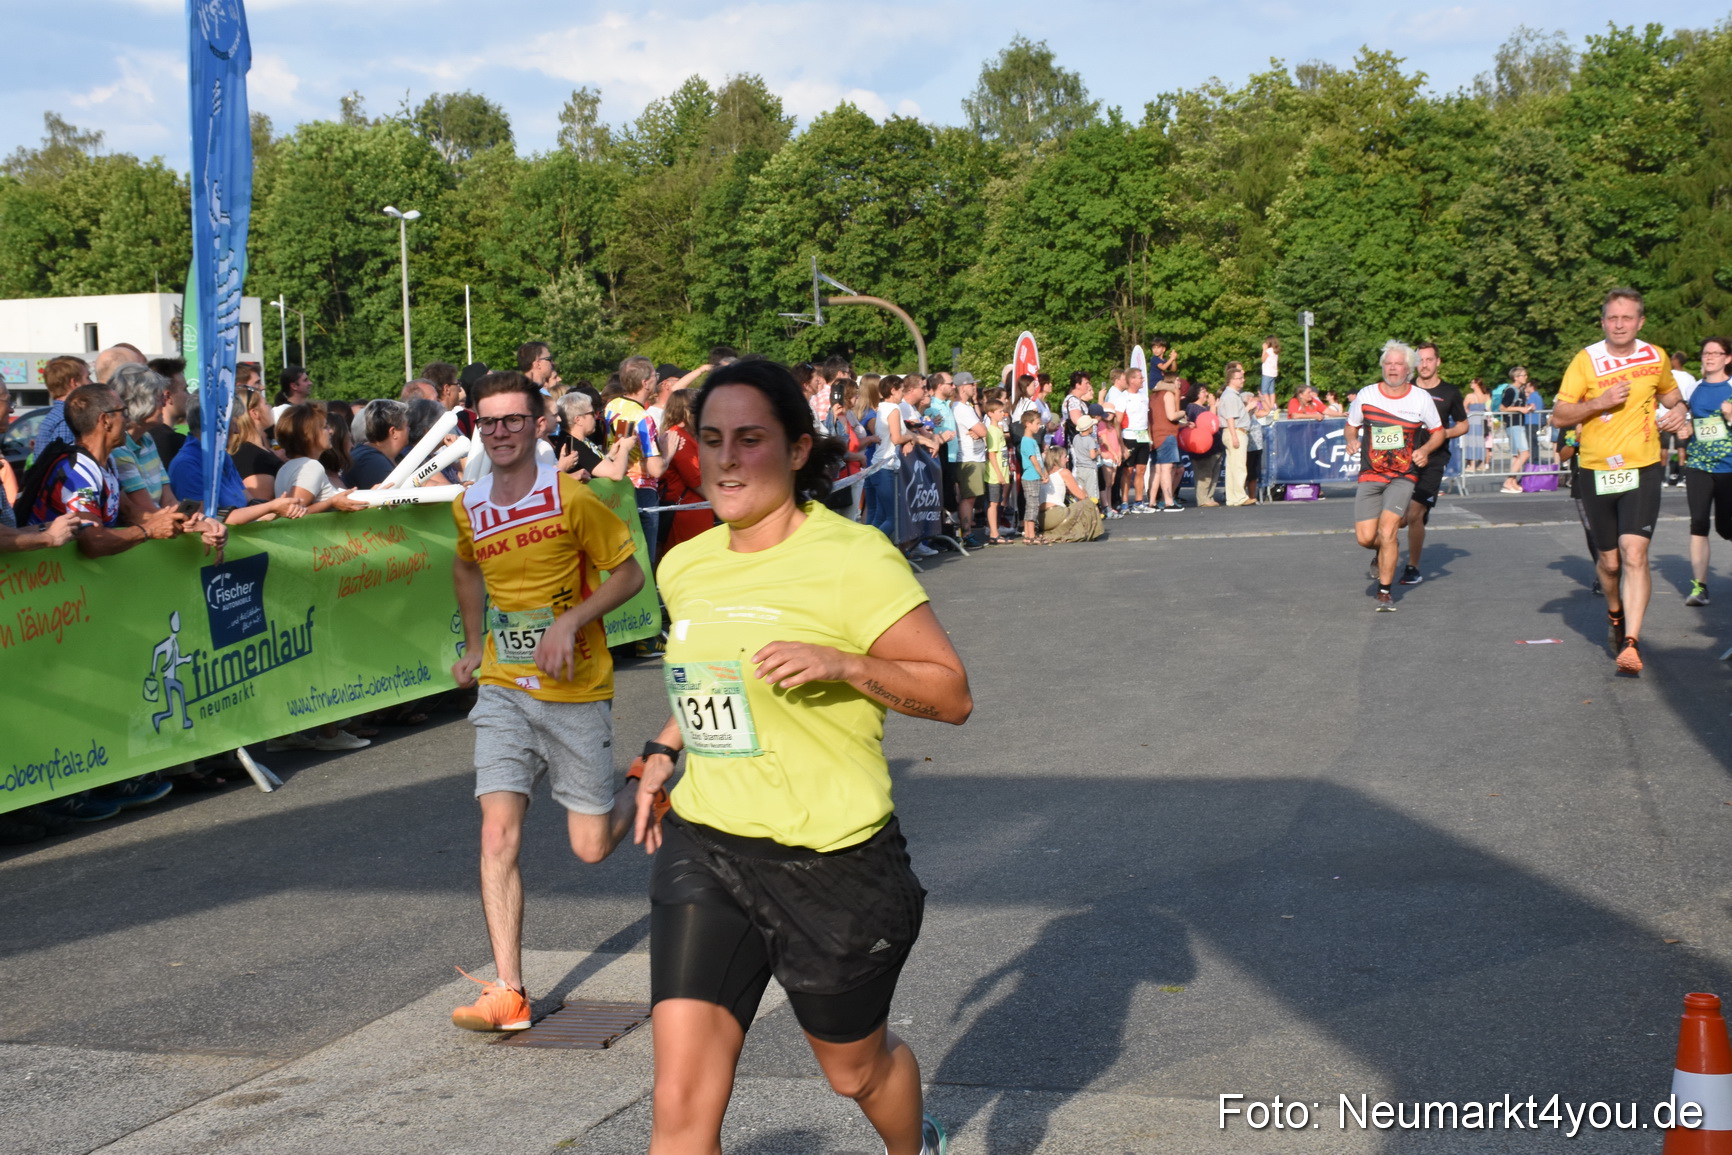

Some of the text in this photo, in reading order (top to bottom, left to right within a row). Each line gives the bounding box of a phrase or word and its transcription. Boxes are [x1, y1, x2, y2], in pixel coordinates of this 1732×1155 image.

[1375, 434, 1399, 444] 2265
[1601, 472, 1633, 485] 1556
[313, 525, 409, 572] Gesunde Firmen
[476, 522, 569, 562] MAX BÖGL
[337, 541, 432, 599] laufen länger!
[215, 581, 255, 604] Fischer
[222, 595, 252, 612] AUTOMOBILE
[17, 584, 90, 645] länger!
[192, 605, 315, 700] firmenlauf
[499, 628, 547, 650] 1557
[200, 681, 255, 720] neumarkt
[287, 659, 432, 717] www.firmenlauf-oberpfalz.de
[677, 696, 737, 731] 1311
